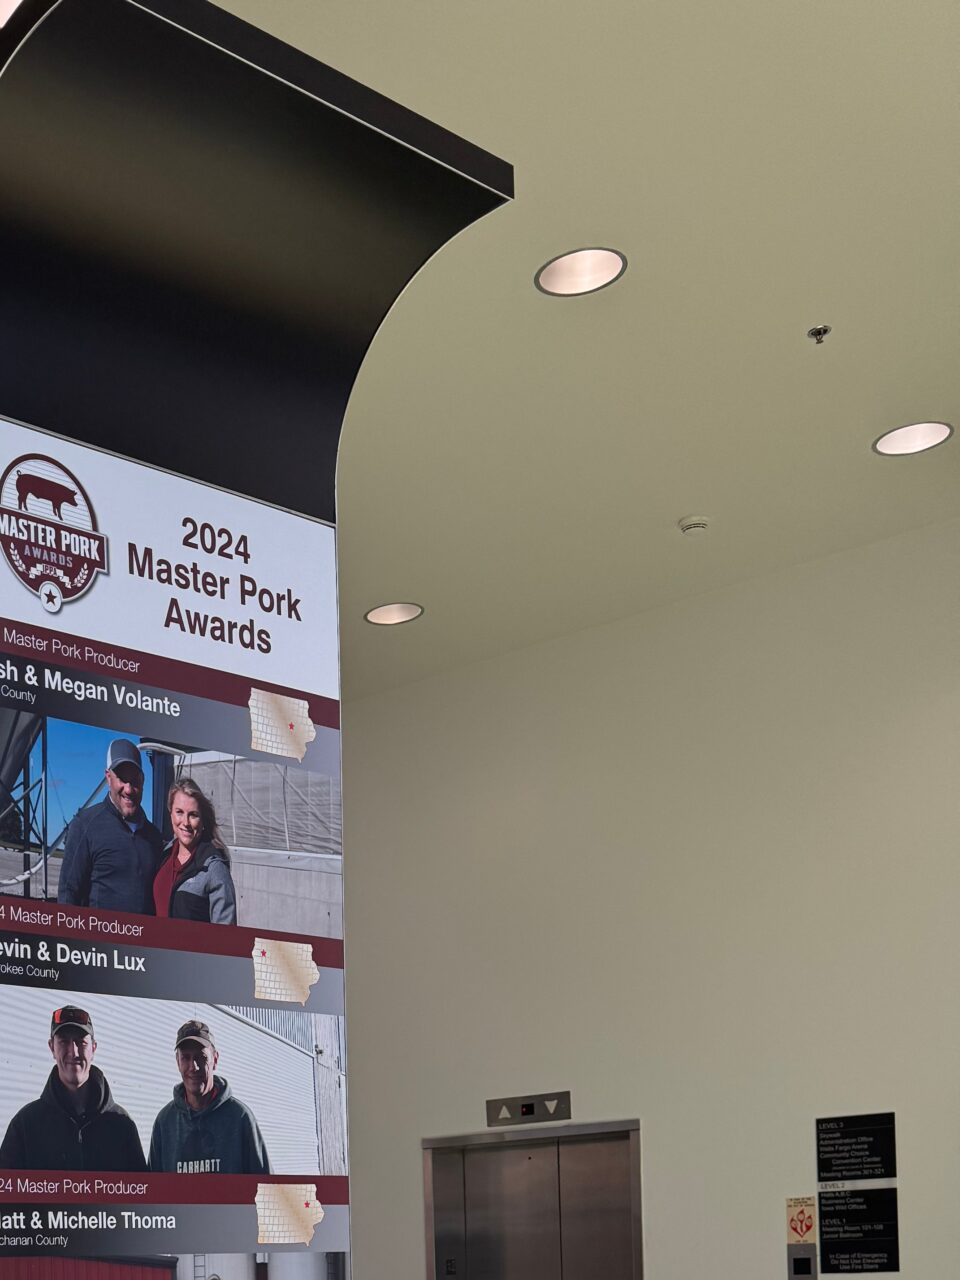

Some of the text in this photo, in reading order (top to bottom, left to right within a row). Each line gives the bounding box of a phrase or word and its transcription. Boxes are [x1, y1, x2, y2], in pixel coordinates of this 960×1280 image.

[24, 545, 73, 567] AWARDS
[60, 530, 100, 561] PORK
[182, 517, 251, 564] 2024
[128, 543, 302, 621] Master Pork
[164, 597, 272, 654] Awards
[4, 628, 47, 651] Master
[53, 639, 81, 660] Pork
[85, 647, 140, 673] Producer
[1, 685, 36, 704] County
[24, 665, 39, 686] &
[45, 668, 108, 701] Megan
[113, 684, 181, 717] Volante
[10, 906, 53, 925] Master
[57, 913, 85, 930] Pork
[89, 917, 144, 937] Producer
[37, 941, 51, 962] &
[57, 943, 107, 967] Devin
[114, 950, 146, 972] Lux
[26, 965, 59, 981] County
[176, 1158, 221, 1174] CARHARTT
[17, 1179, 60, 1193] Master
[64, 1179, 91, 1194] Pork
[95, 1180, 148, 1195] Producer
[30, 1211, 43, 1230] &
[48, 1211, 116, 1230] Michelle
[121, 1212, 175, 1229] Thoma
[35, 1234, 68, 1248] County
